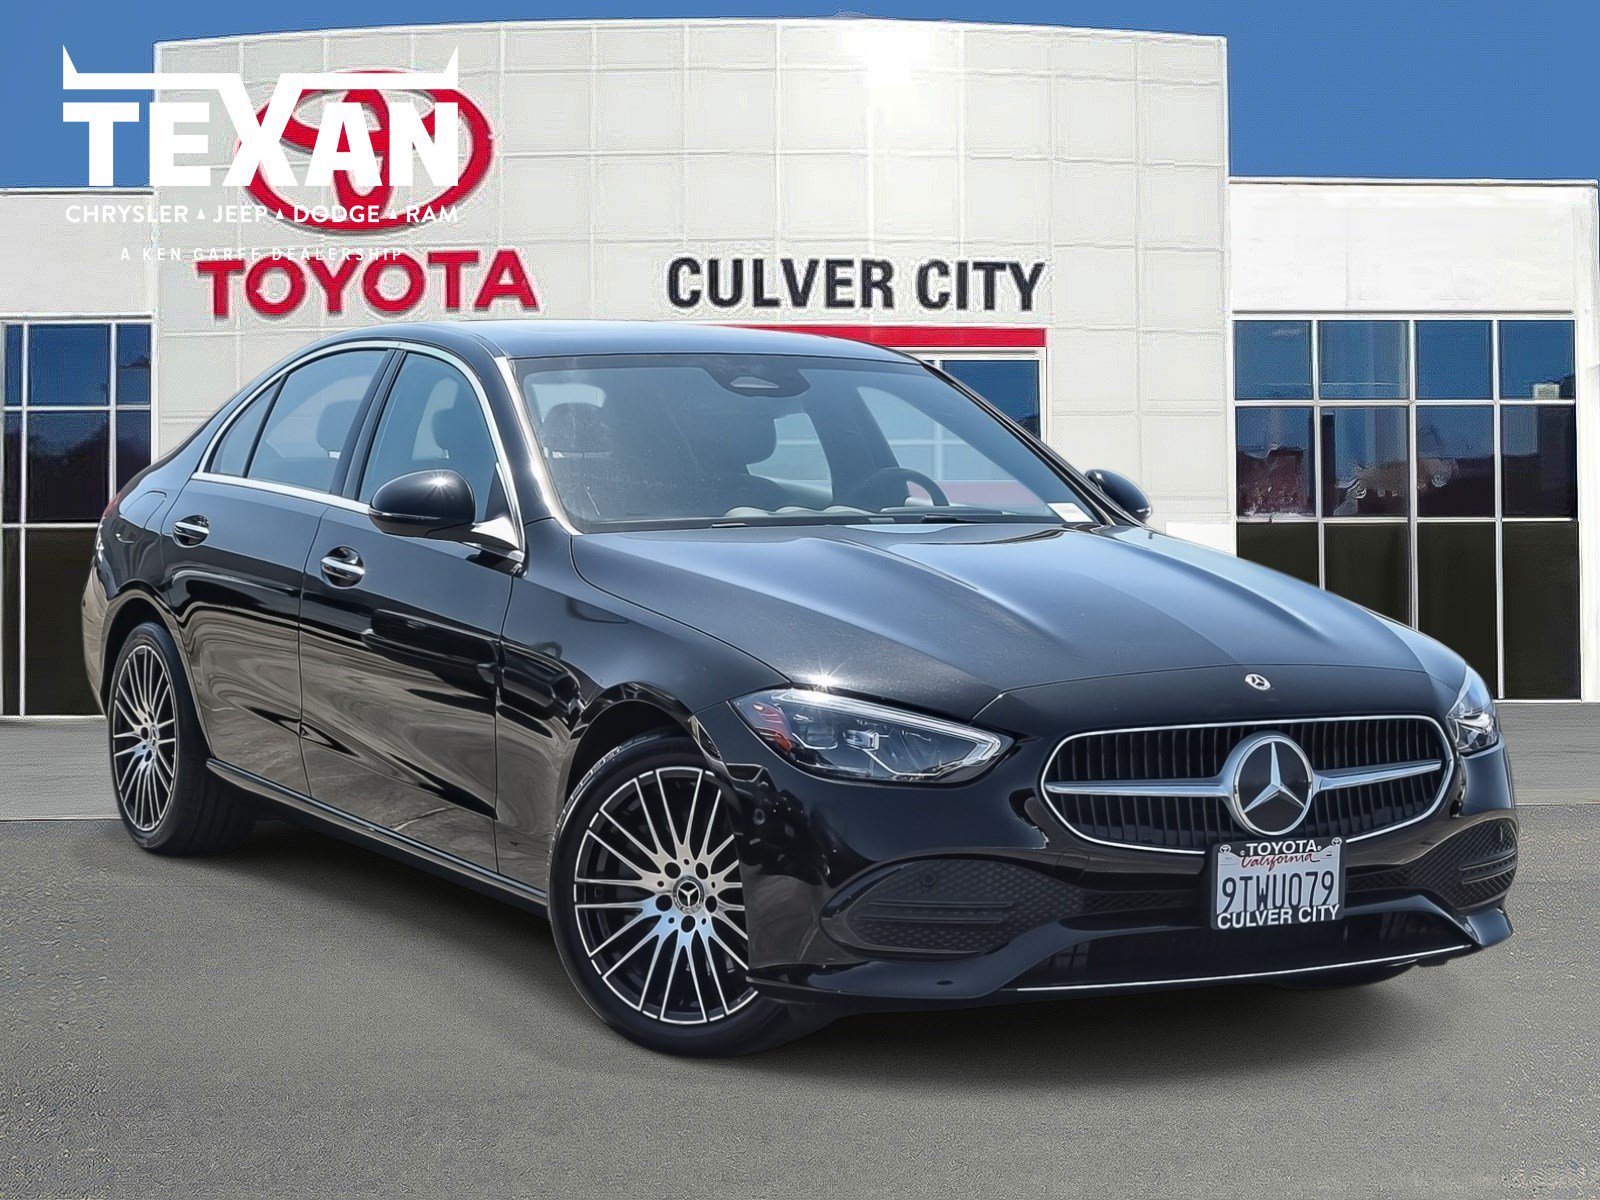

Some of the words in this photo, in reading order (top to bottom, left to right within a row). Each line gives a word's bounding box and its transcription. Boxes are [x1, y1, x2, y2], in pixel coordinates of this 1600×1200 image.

[197, 250, 539, 320] TOYOTA
[668, 257, 895, 310] CULVER
[917, 258, 1046, 312] CITY
[1241, 853, 1320, 871] California
[1246, 839, 1317, 856] TOYOTA
[1221, 870, 1335, 914] 9TWU079
[1217, 909, 1292, 929] CULVER
[1298, 903, 1340, 923] CITY
